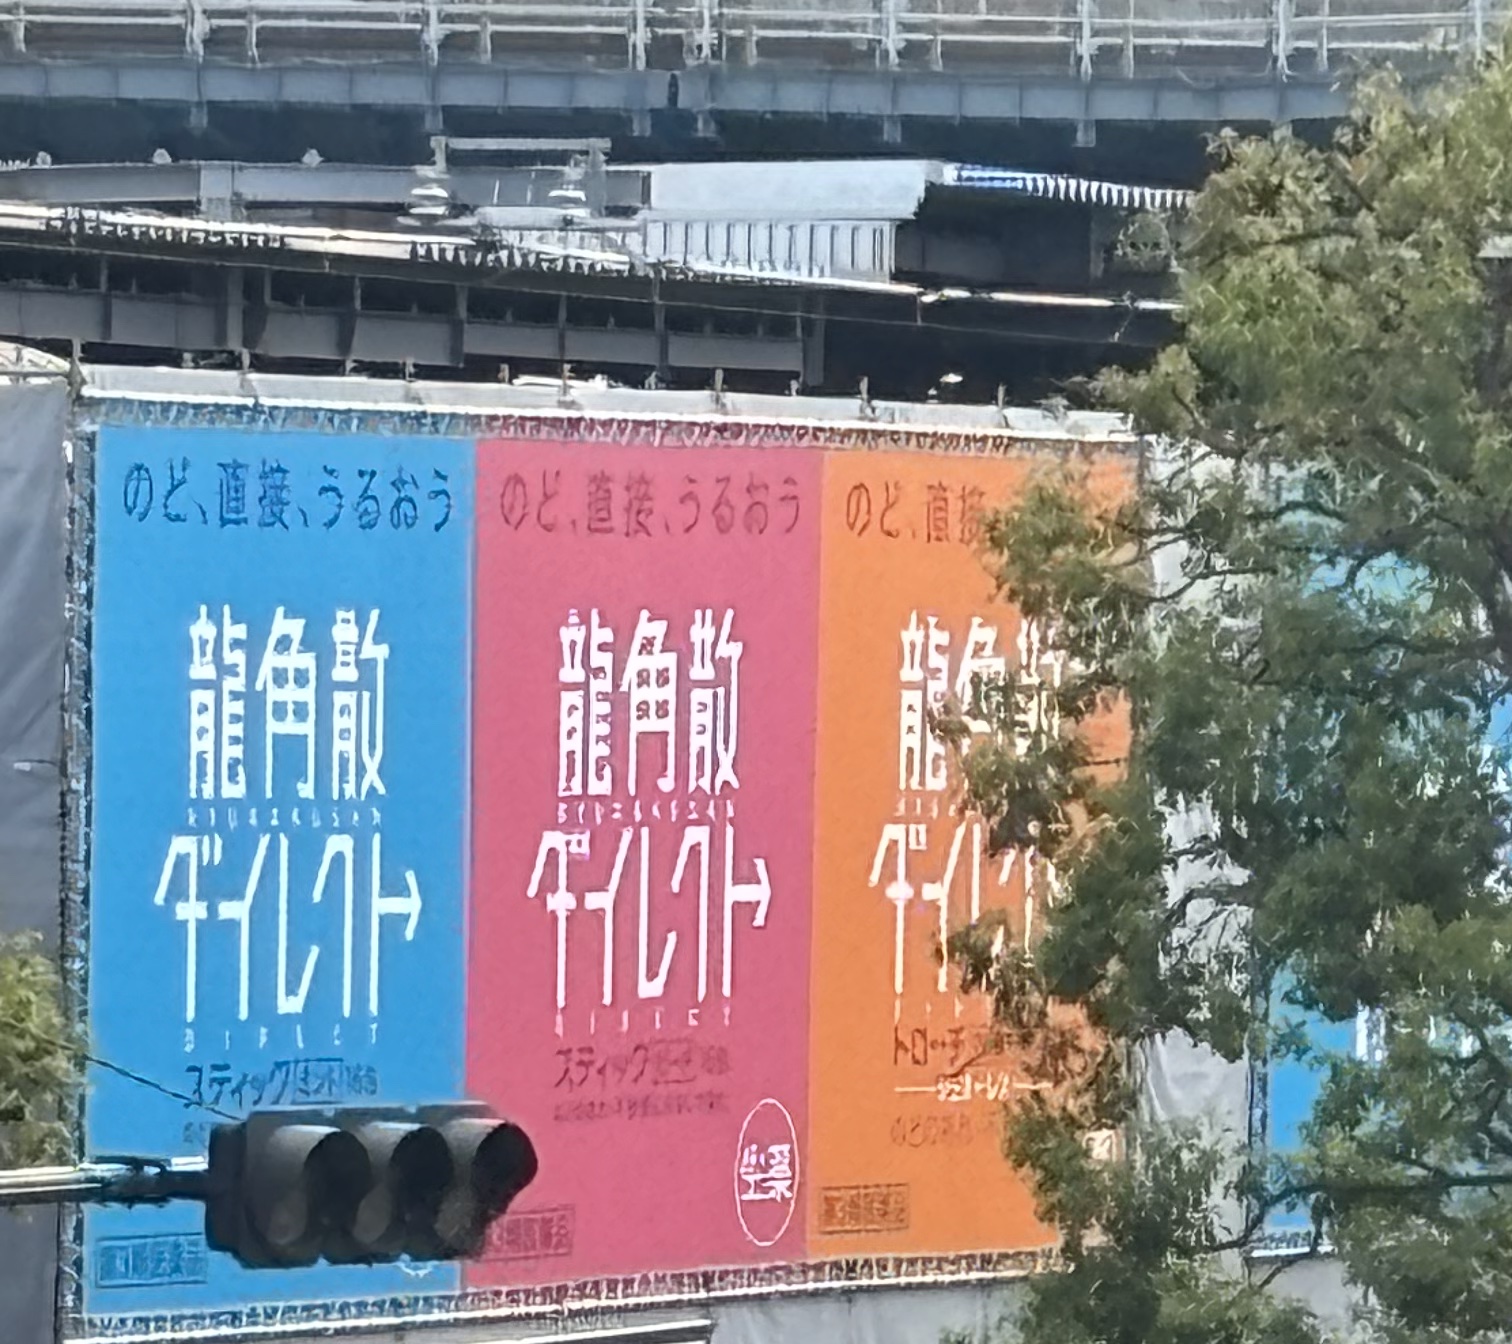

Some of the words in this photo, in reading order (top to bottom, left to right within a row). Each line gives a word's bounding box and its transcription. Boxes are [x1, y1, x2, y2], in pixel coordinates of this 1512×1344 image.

[123, 457, 453, 532] のど、直接、うるおう
[500, 468, 800, 538] のど、直接、うるおう
[846, 479, 988, 544] のど、直接
[189, 604, 390, 801] 龍角散
[557, 608, 743, 797] 龍角散
[154, 832, 422, 1023] ダイレクト
[527, 822, 771, 1007] ダイレクト
